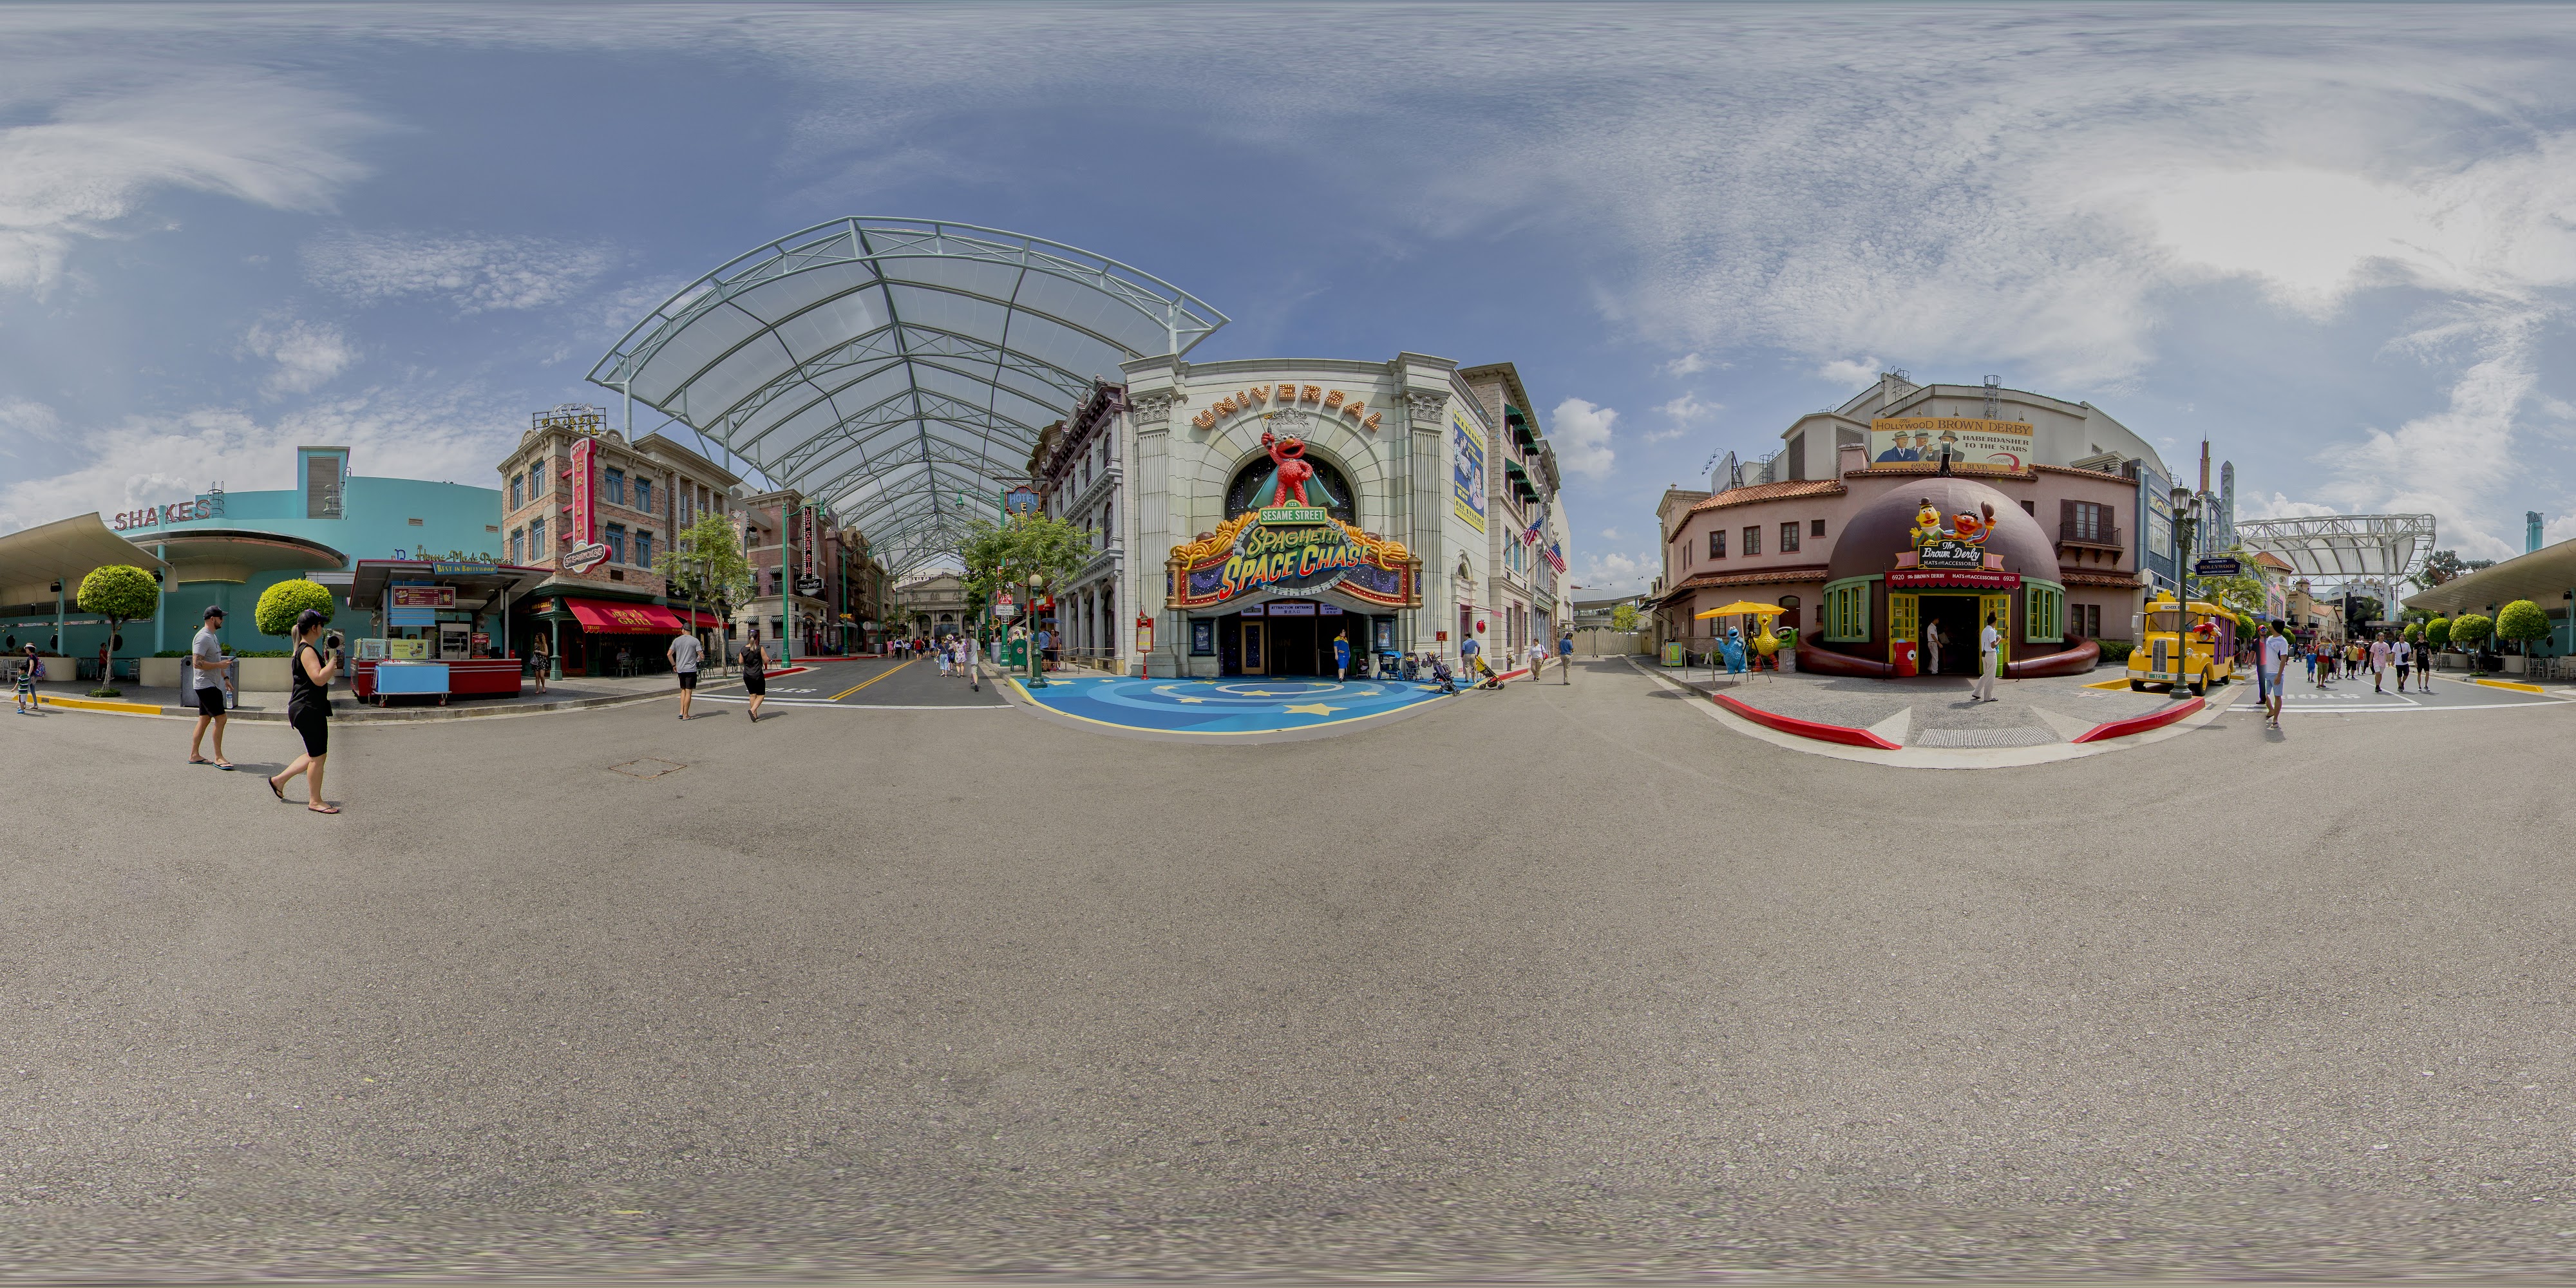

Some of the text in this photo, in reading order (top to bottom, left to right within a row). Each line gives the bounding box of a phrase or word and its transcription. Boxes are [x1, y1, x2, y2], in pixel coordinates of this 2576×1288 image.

[1192, 384, 1382, 432] UNIVERSAL
[1876, 420, 2031, 435] HOLLYWOOD BROWN DERBY
[1963, 435, 2029, 445] HABERDASHER
[575, 462, 583, 531] GRILL
[1009, 493, 1037, 506] HOTEL
[114, 500, 211, 531] SHAKES
[1262, 510, 1323, 521] SESAME STREET
[1245, 526, 1341, 558] SPAGHETTI
[1942, 541, 1955, 549] The
[565, 547, 603, 566] STEAKHOUSE
[1922, 547, 1980, 562] Brown Derby
[437, 564, 452, 573] BEST
[1218, 544, 1372, 601] SPACE CHASE
[618, 618, 654, 626] GRILL
